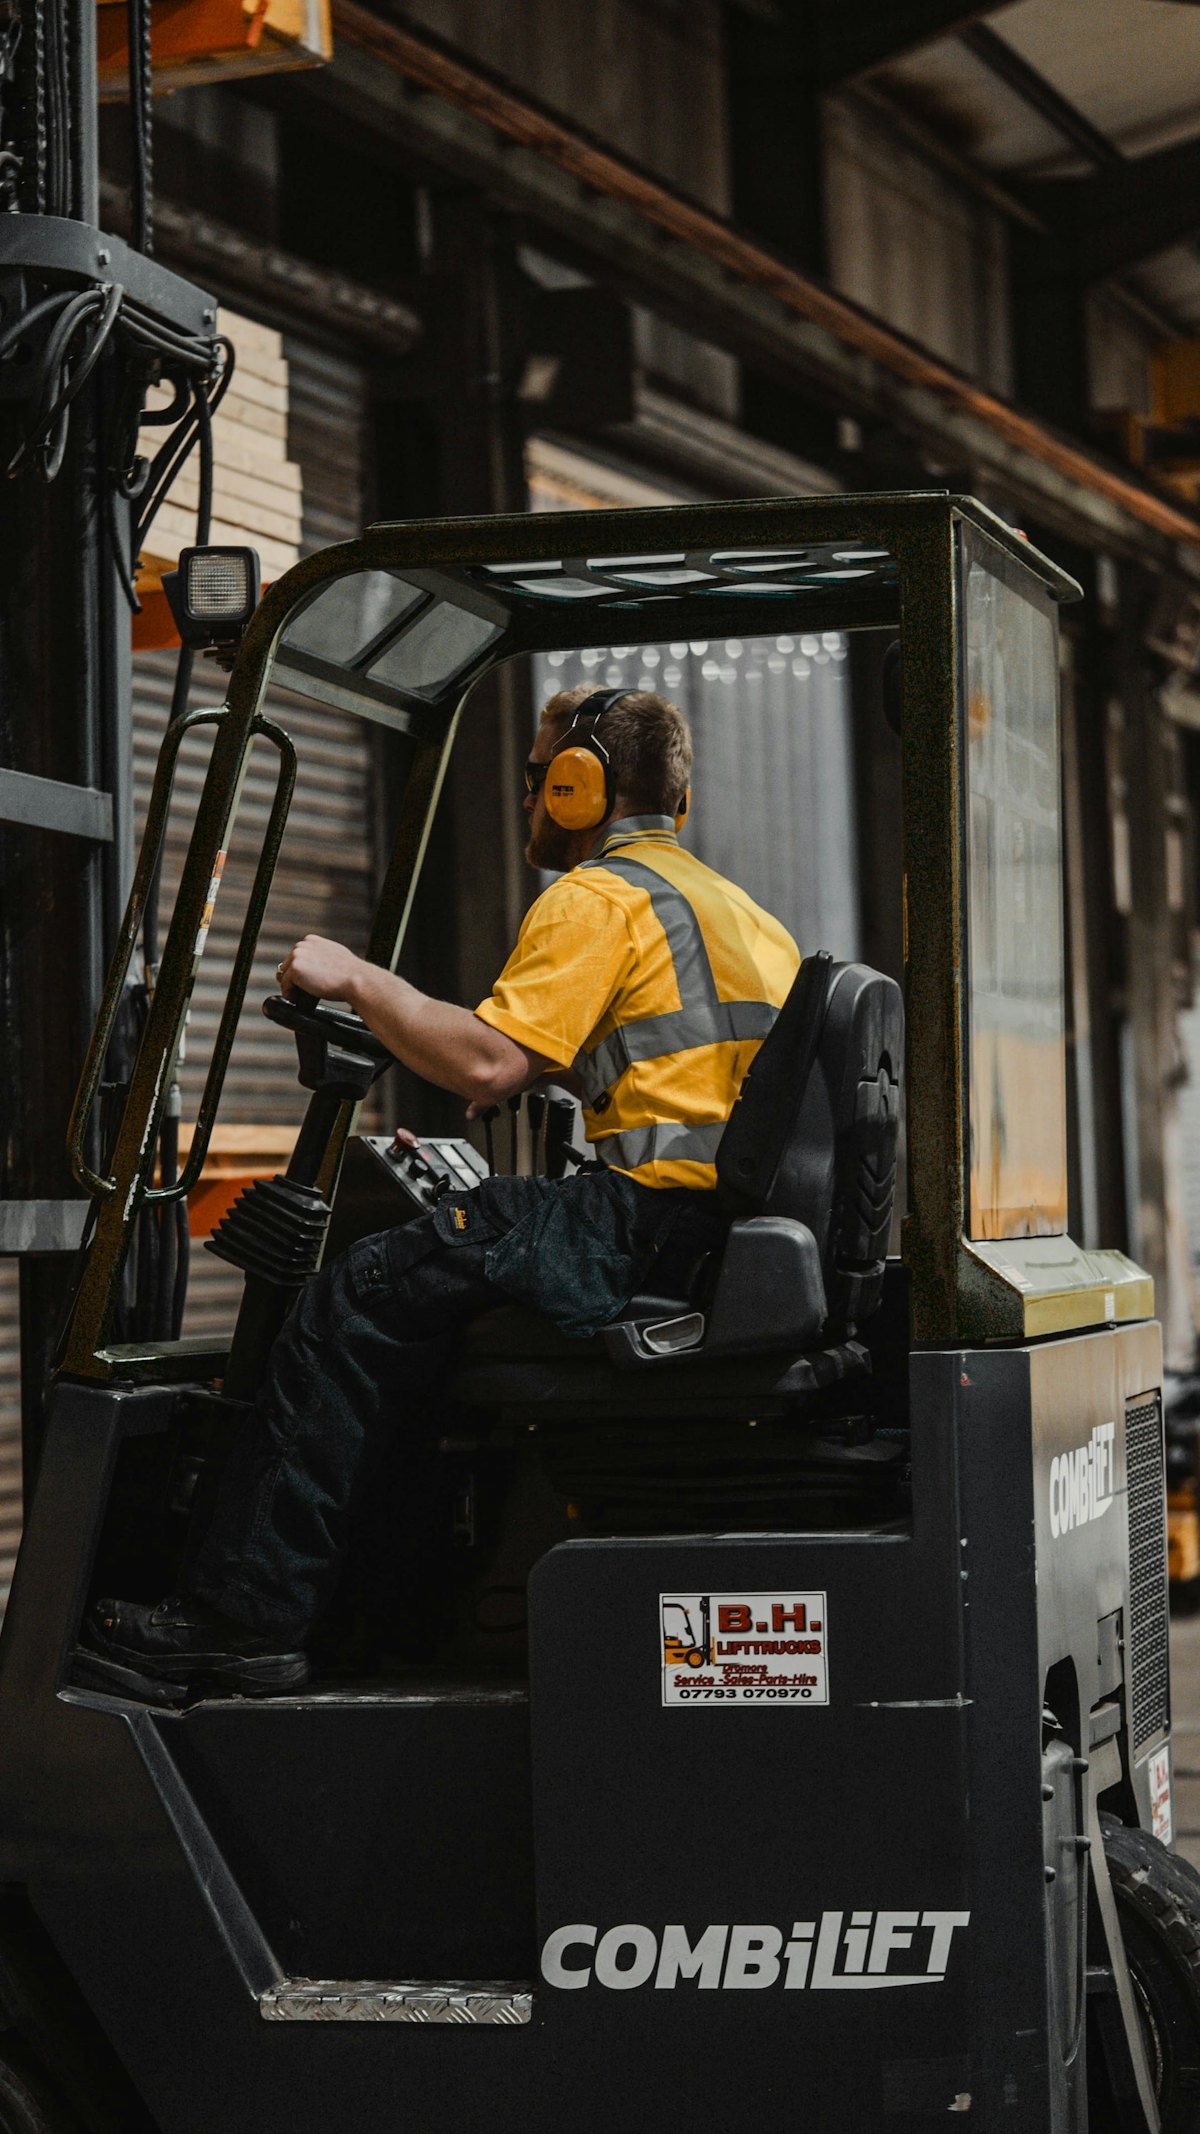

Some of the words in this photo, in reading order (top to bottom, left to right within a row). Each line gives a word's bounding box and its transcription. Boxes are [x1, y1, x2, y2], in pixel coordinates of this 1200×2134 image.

[718, 1603, 822, 1633] B.H.
[717, 1640, 821, 1655] LIFTTRUCKS
[722, 1663, 768, 1673] Dromore
[674, 1674, 714, 1686] Service
[679, 1689, 737, 1698] 07793
[743, 1688, 812, 1698] 070970
